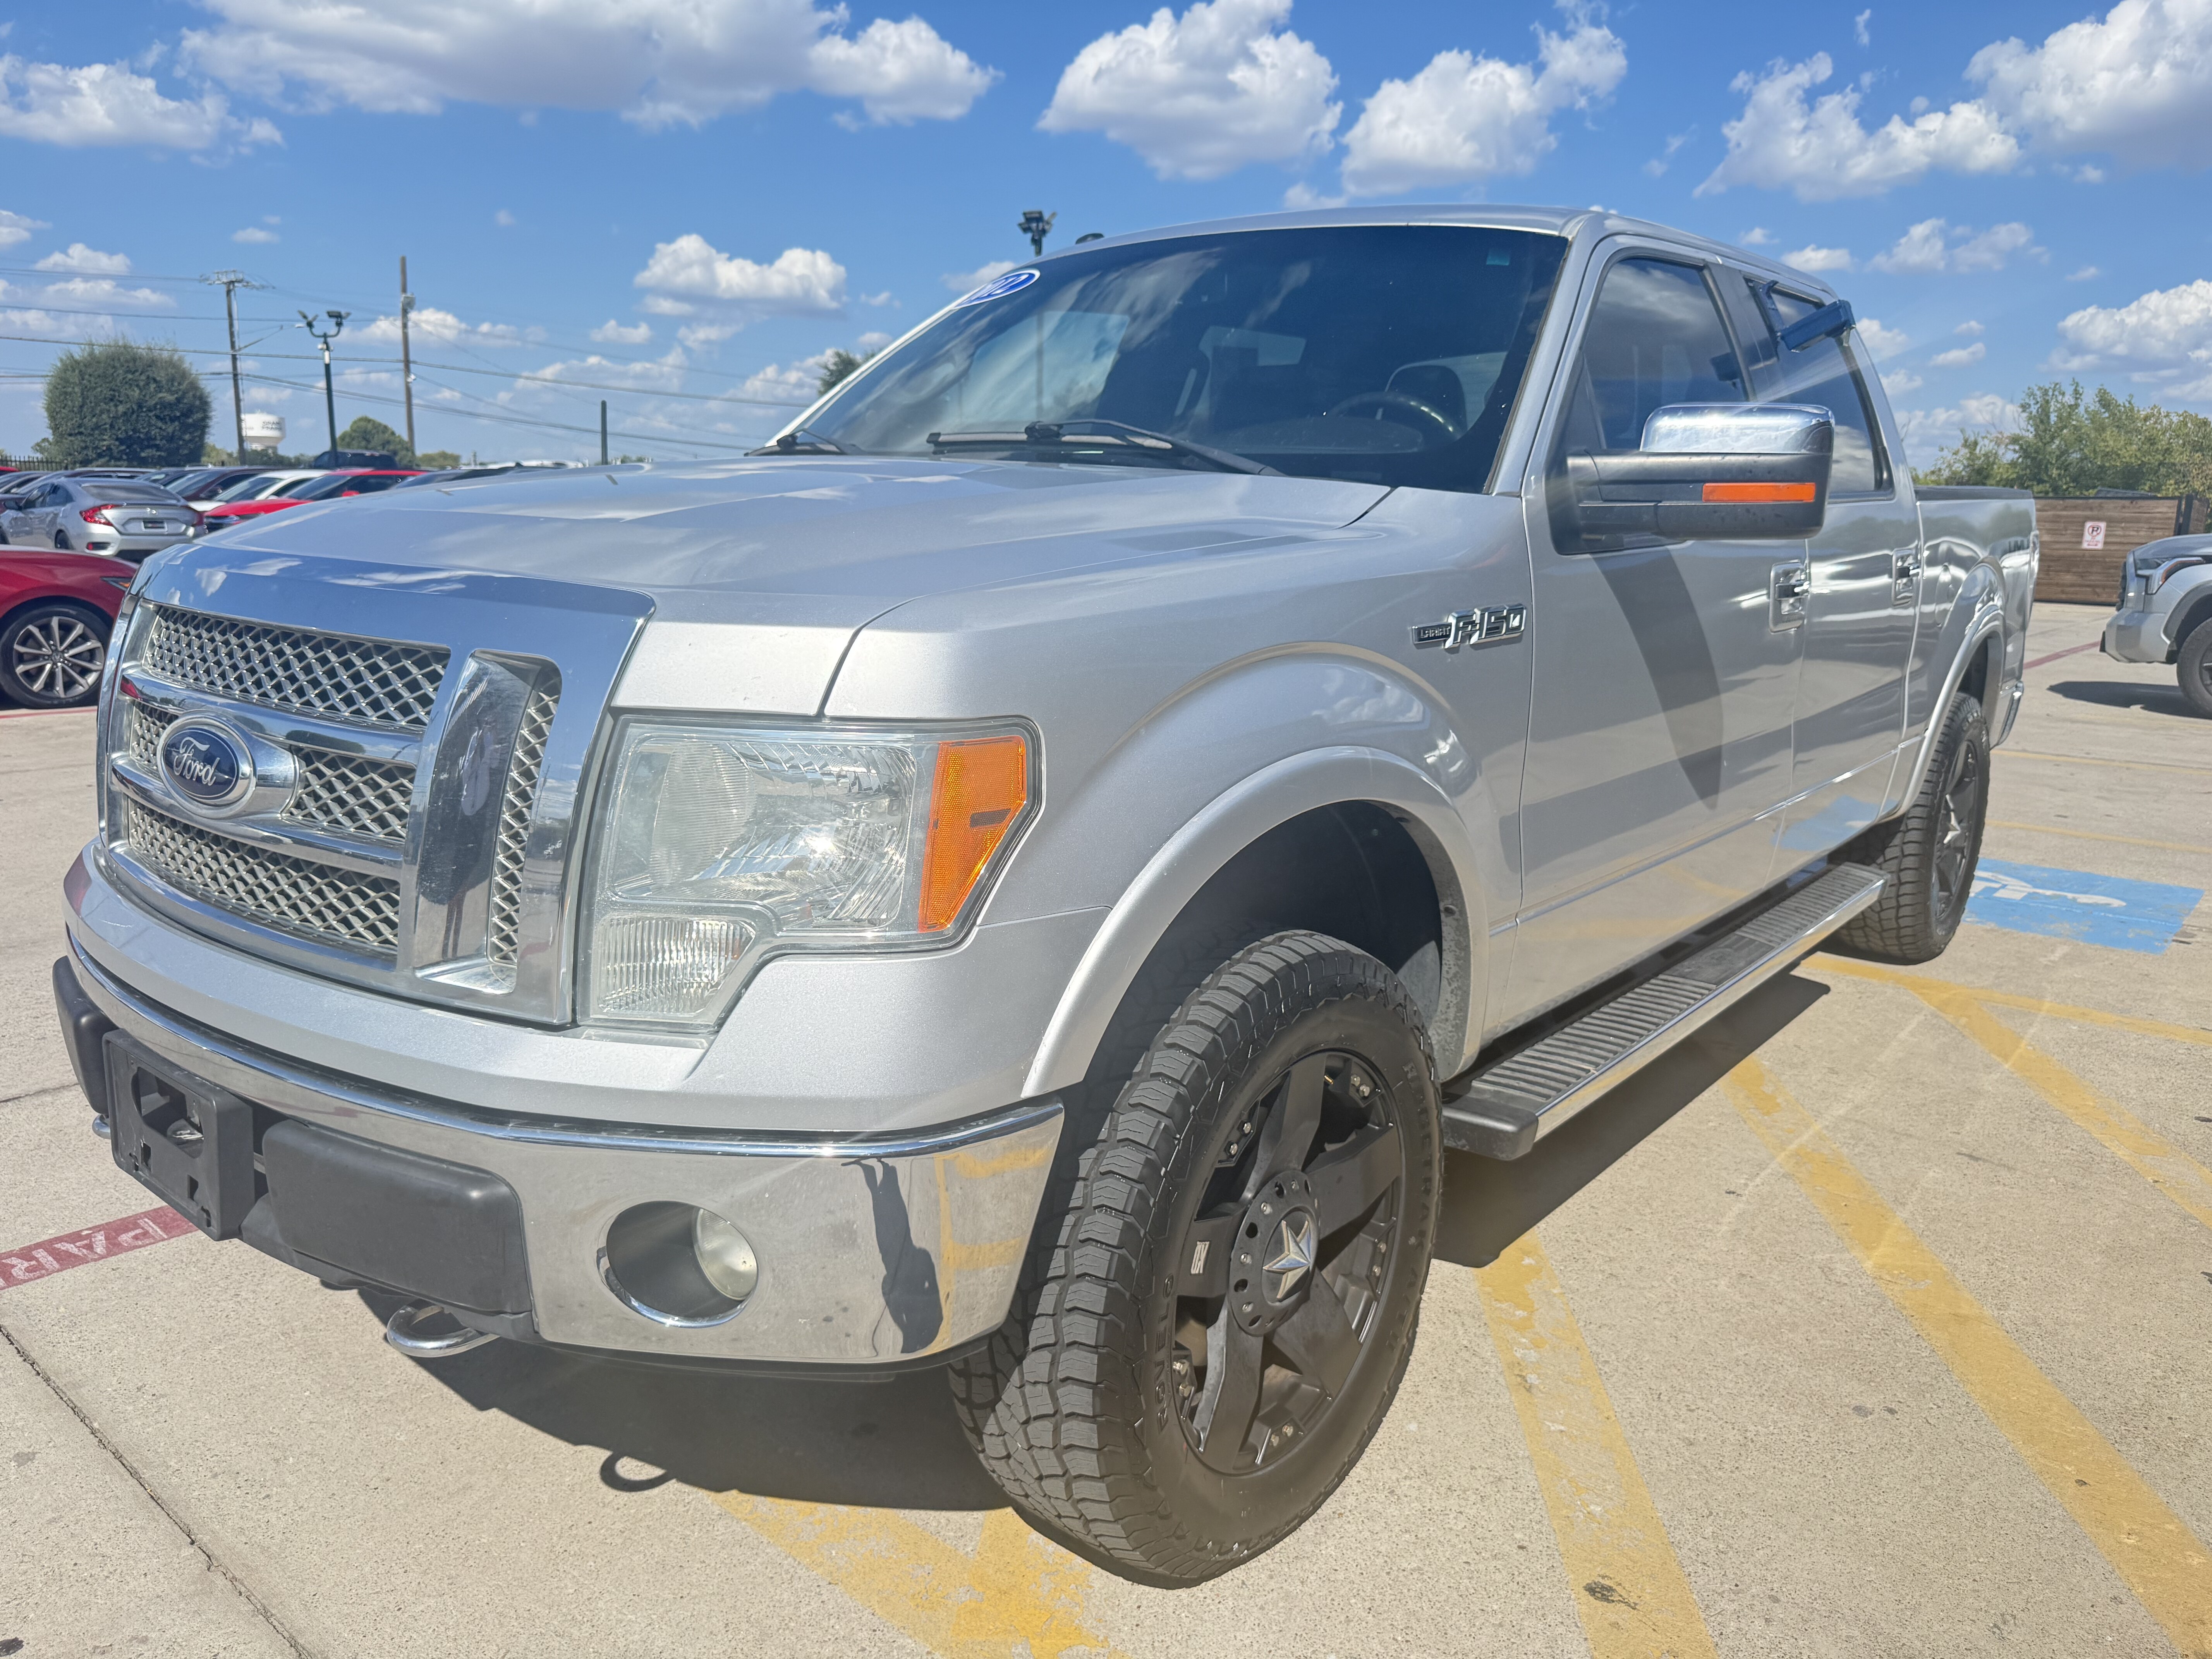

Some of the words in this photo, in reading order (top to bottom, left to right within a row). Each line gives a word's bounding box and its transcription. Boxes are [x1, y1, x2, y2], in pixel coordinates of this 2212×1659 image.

[1420, 626, 1451, 638] LARIAT
[173, 737, 220, 786] Ford
[0, 1218, 167, 1287] PAR
[1154, 1273, 1174, 1434] ROVELO
